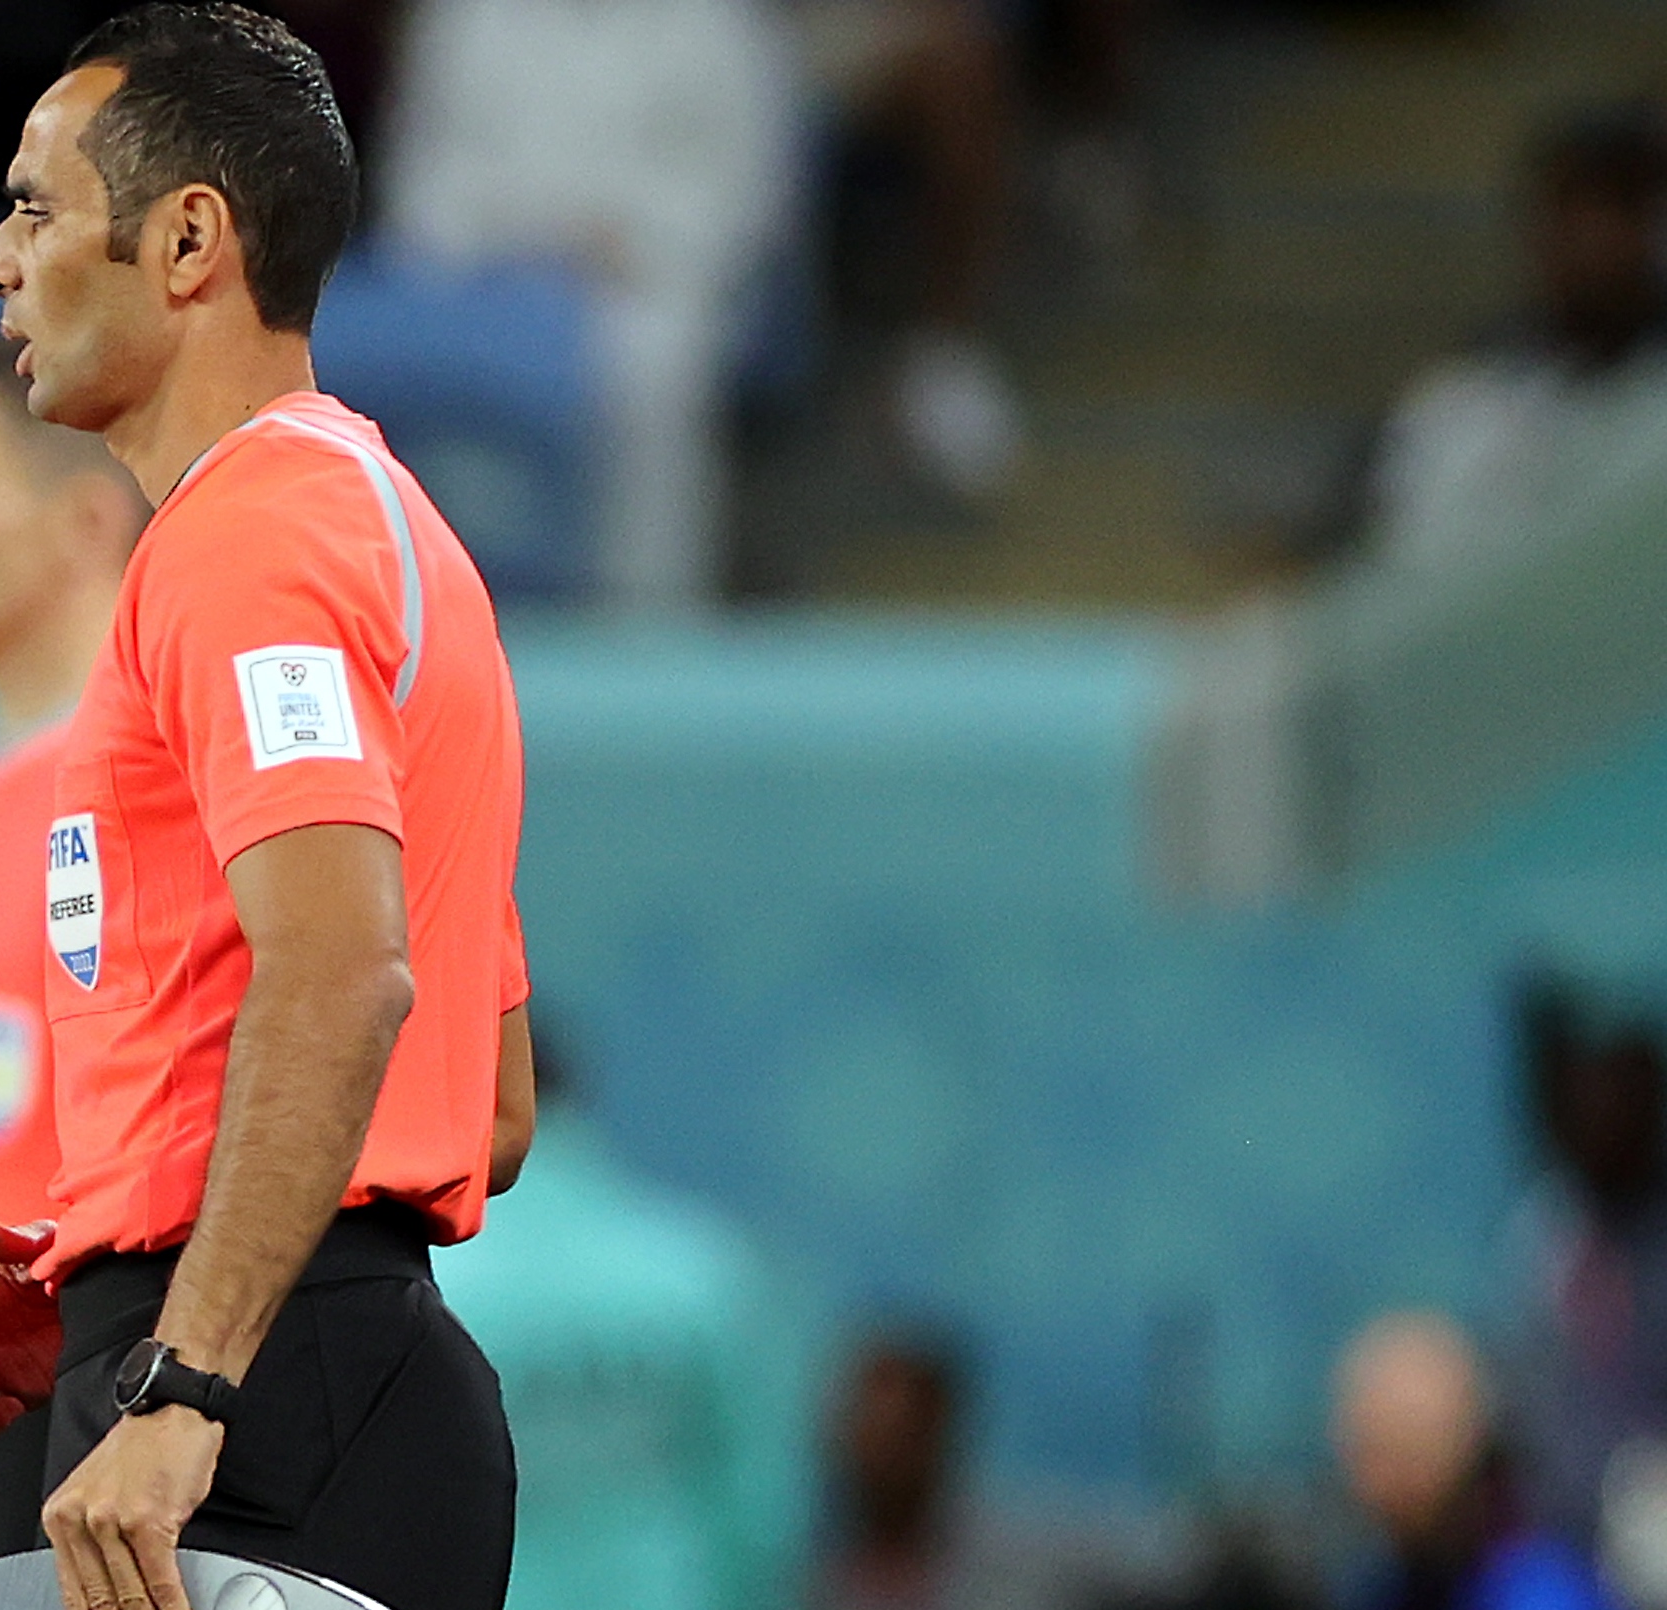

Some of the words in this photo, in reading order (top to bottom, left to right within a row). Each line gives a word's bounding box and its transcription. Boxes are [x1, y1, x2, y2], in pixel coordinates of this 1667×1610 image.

[279, 702, 322, 717] UNITES
[49, 825, 89, 871] FIFA
[50, 893, 95, 921] REFEREE
